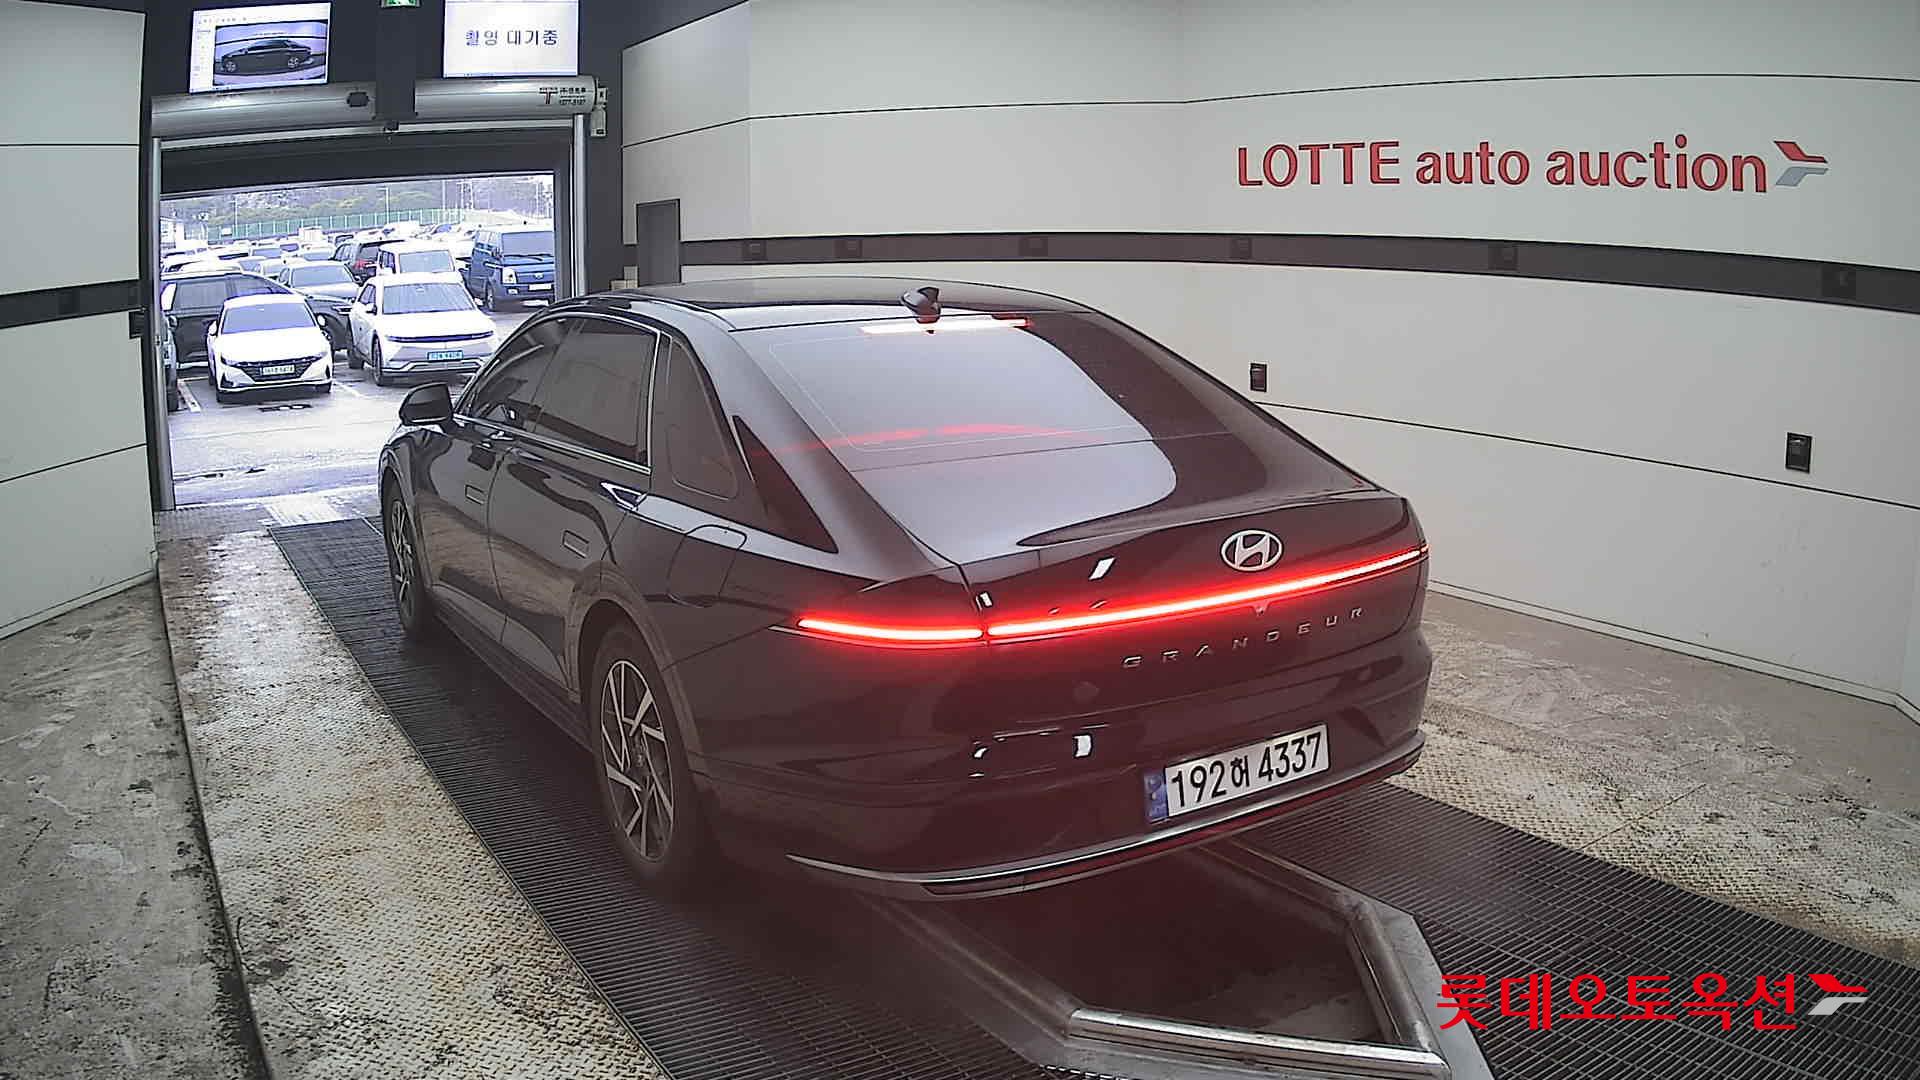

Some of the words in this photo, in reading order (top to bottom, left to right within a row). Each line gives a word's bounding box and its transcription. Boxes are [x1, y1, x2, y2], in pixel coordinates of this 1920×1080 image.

[506, 29, 559, 46] 대기중
[1237, 140, 1401, 187] LOTTE
[1415, 141, 1531, 187] auto
[1545, 134, 1768, 193] auction
[1122, 607, 1363, 668] GRANDEUR
[1170, 756, 1250, 807] 192허
[1258, 732, 1322, 782] 4337
